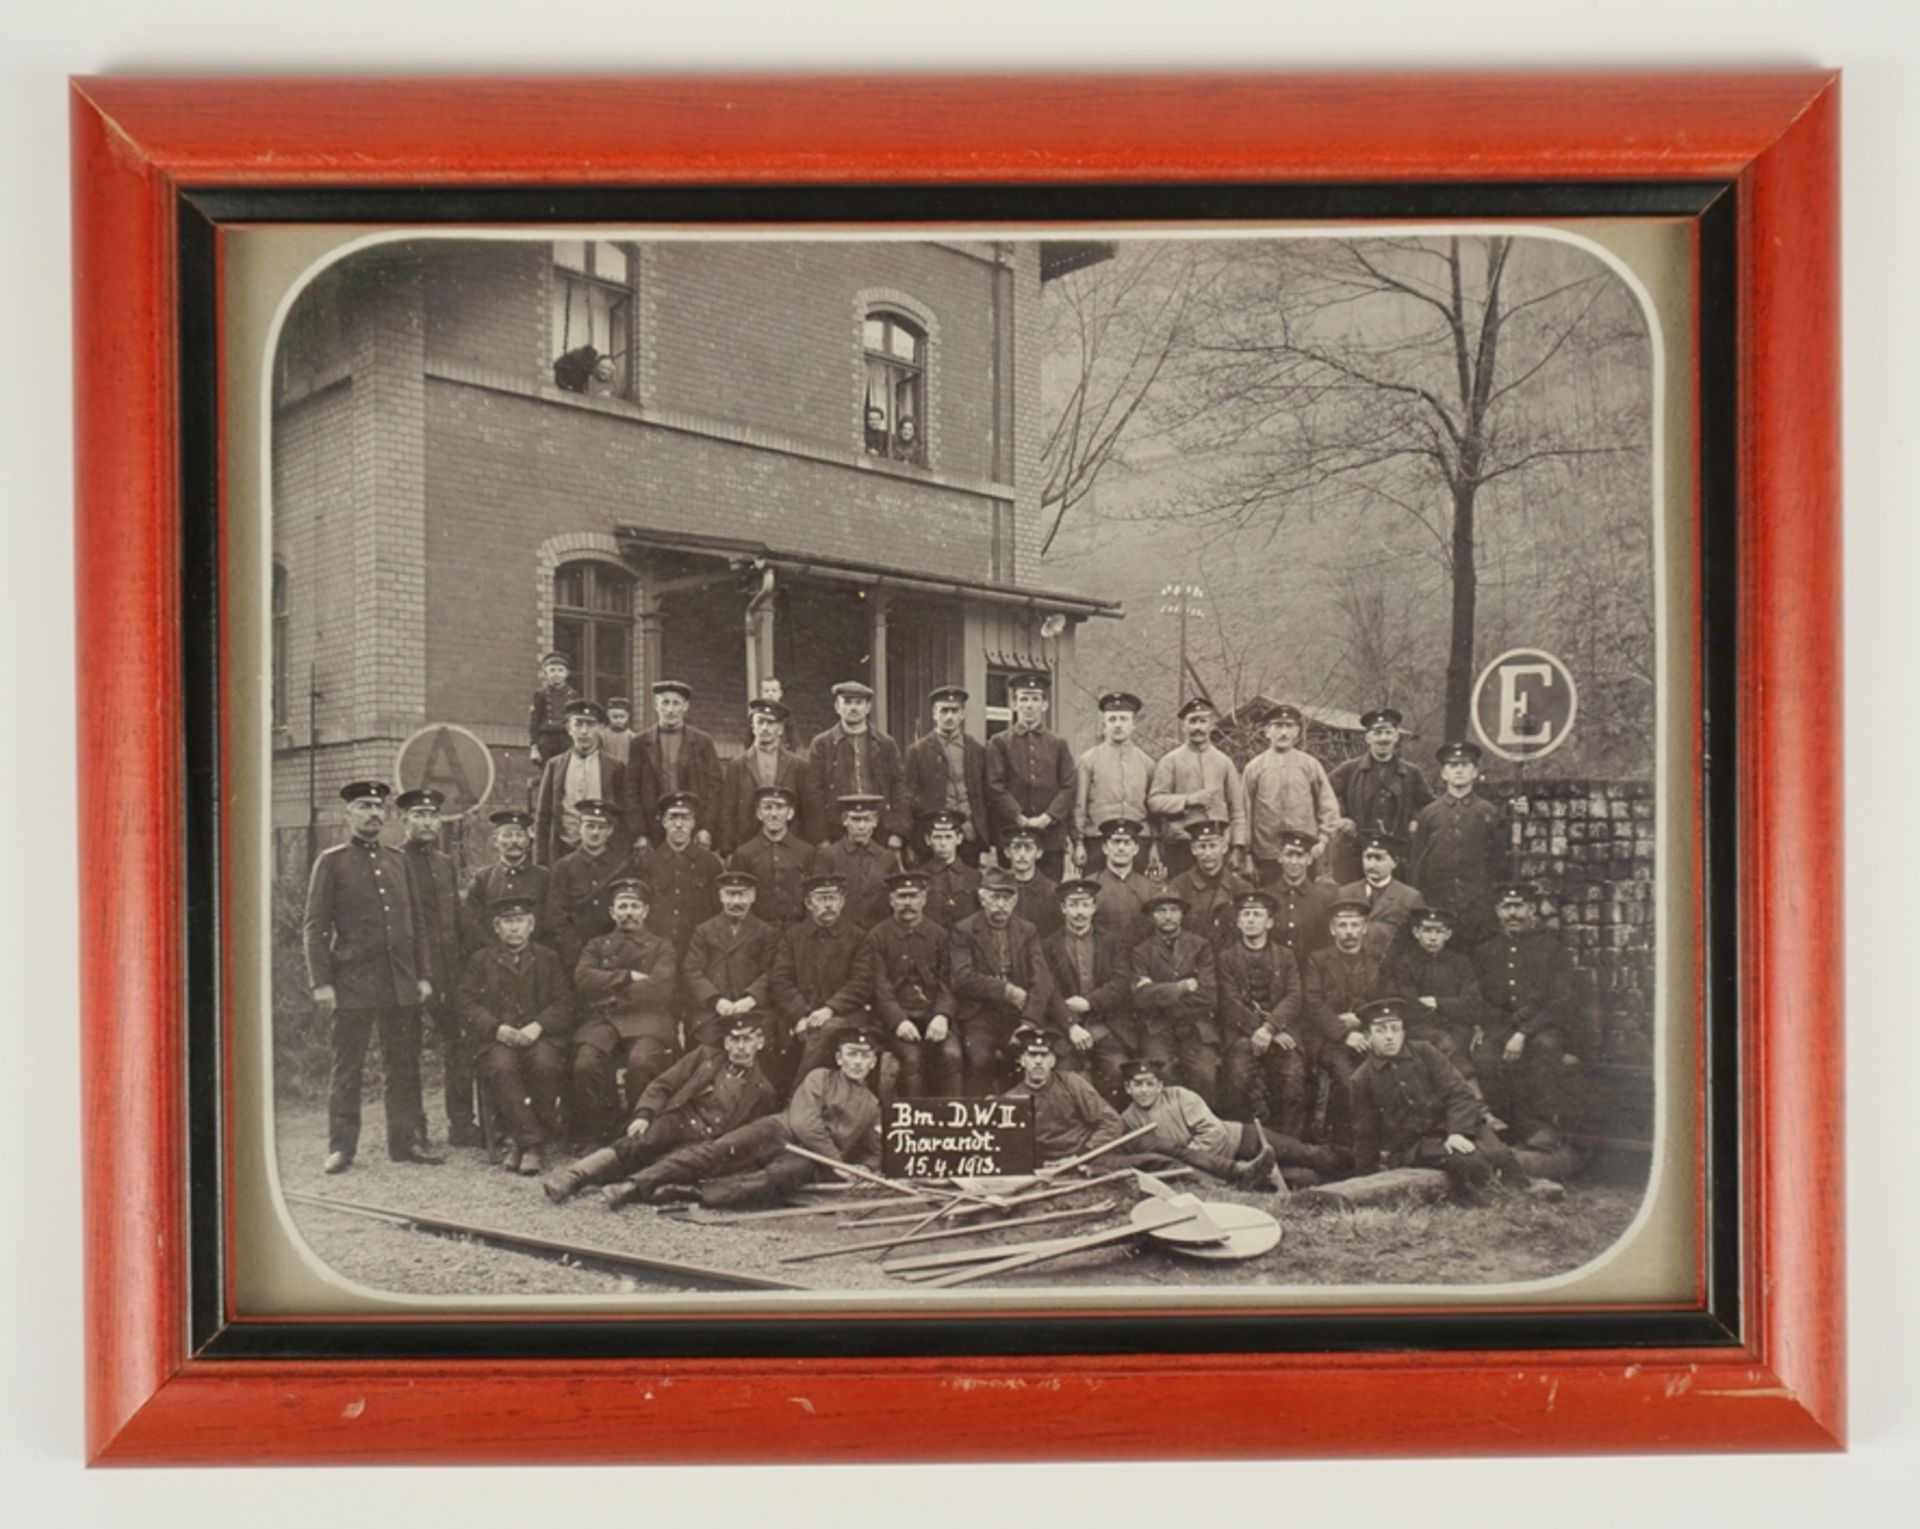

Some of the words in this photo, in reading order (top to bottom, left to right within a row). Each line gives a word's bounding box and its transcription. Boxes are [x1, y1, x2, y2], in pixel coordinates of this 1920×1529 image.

[1497, 664, 1552, 744] E
[416, 727, 479, 804] A
[891, 1102, 944, 1127] Bm.
[887, 1129, 1001, 1153] Tharandt.
